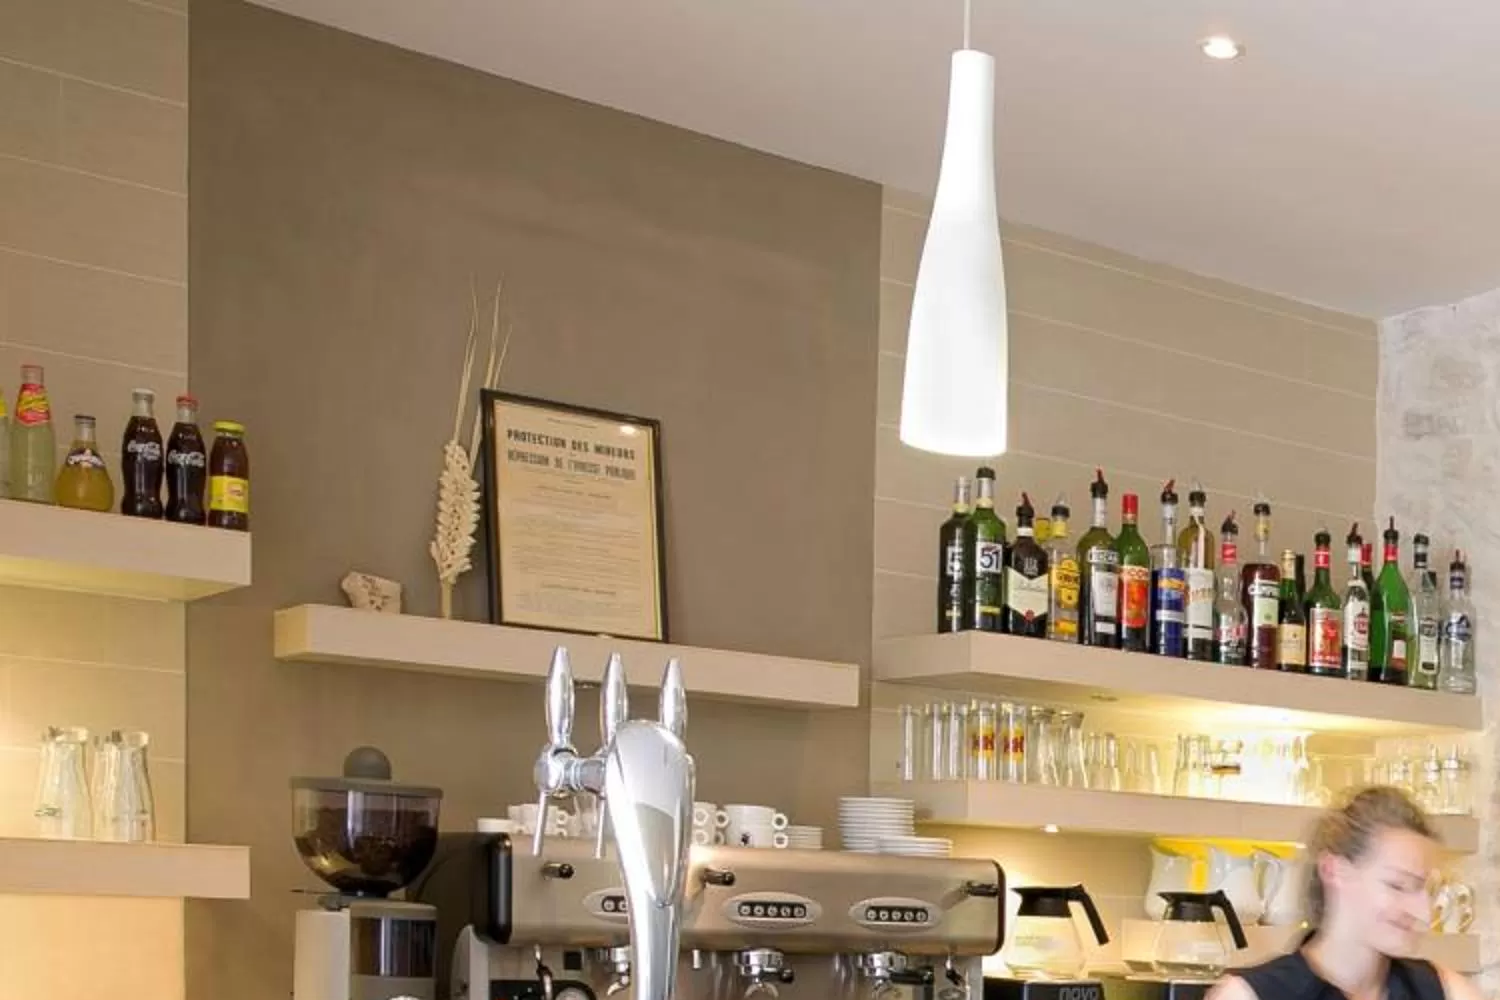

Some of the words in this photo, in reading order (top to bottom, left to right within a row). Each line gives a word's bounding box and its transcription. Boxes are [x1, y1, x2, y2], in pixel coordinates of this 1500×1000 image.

[507, 428, 566, 449] PROTECTION
[571, 439, 588, 453] DES
[980, 546, 1000, 569] 51
